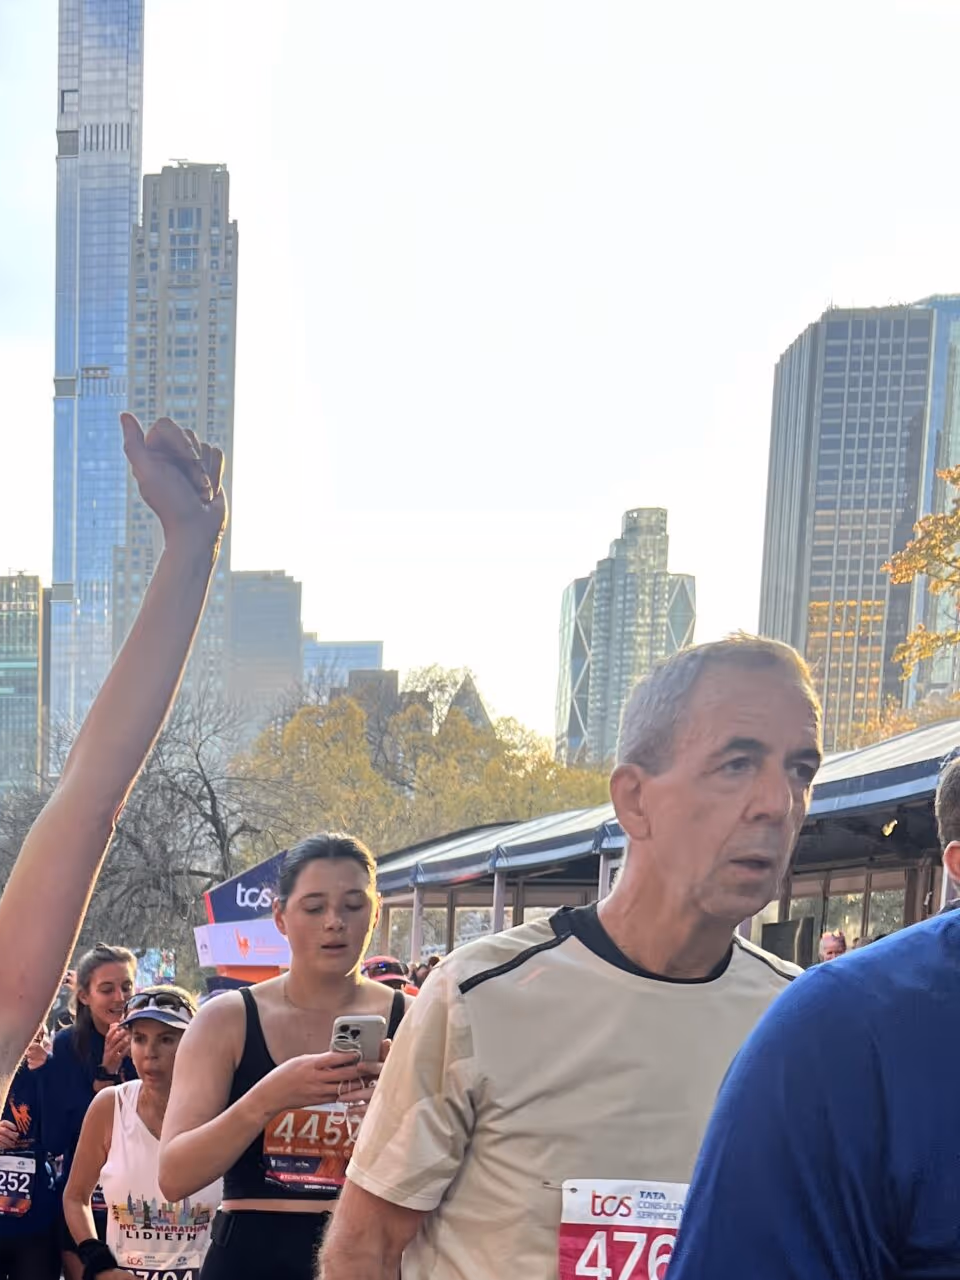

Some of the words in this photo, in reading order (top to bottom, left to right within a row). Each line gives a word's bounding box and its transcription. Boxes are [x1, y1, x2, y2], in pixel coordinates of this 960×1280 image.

[236, 882, 272, 908] tcs
[591, 1190, 632, 1217] tcs
[640, 1190, 666, 1201] TATA
[637, 1211, 678, 1222] SERVICES
[119, 1223, 138, 1231] NYC
[125, 1230, 197, 1241] LIDIETH
